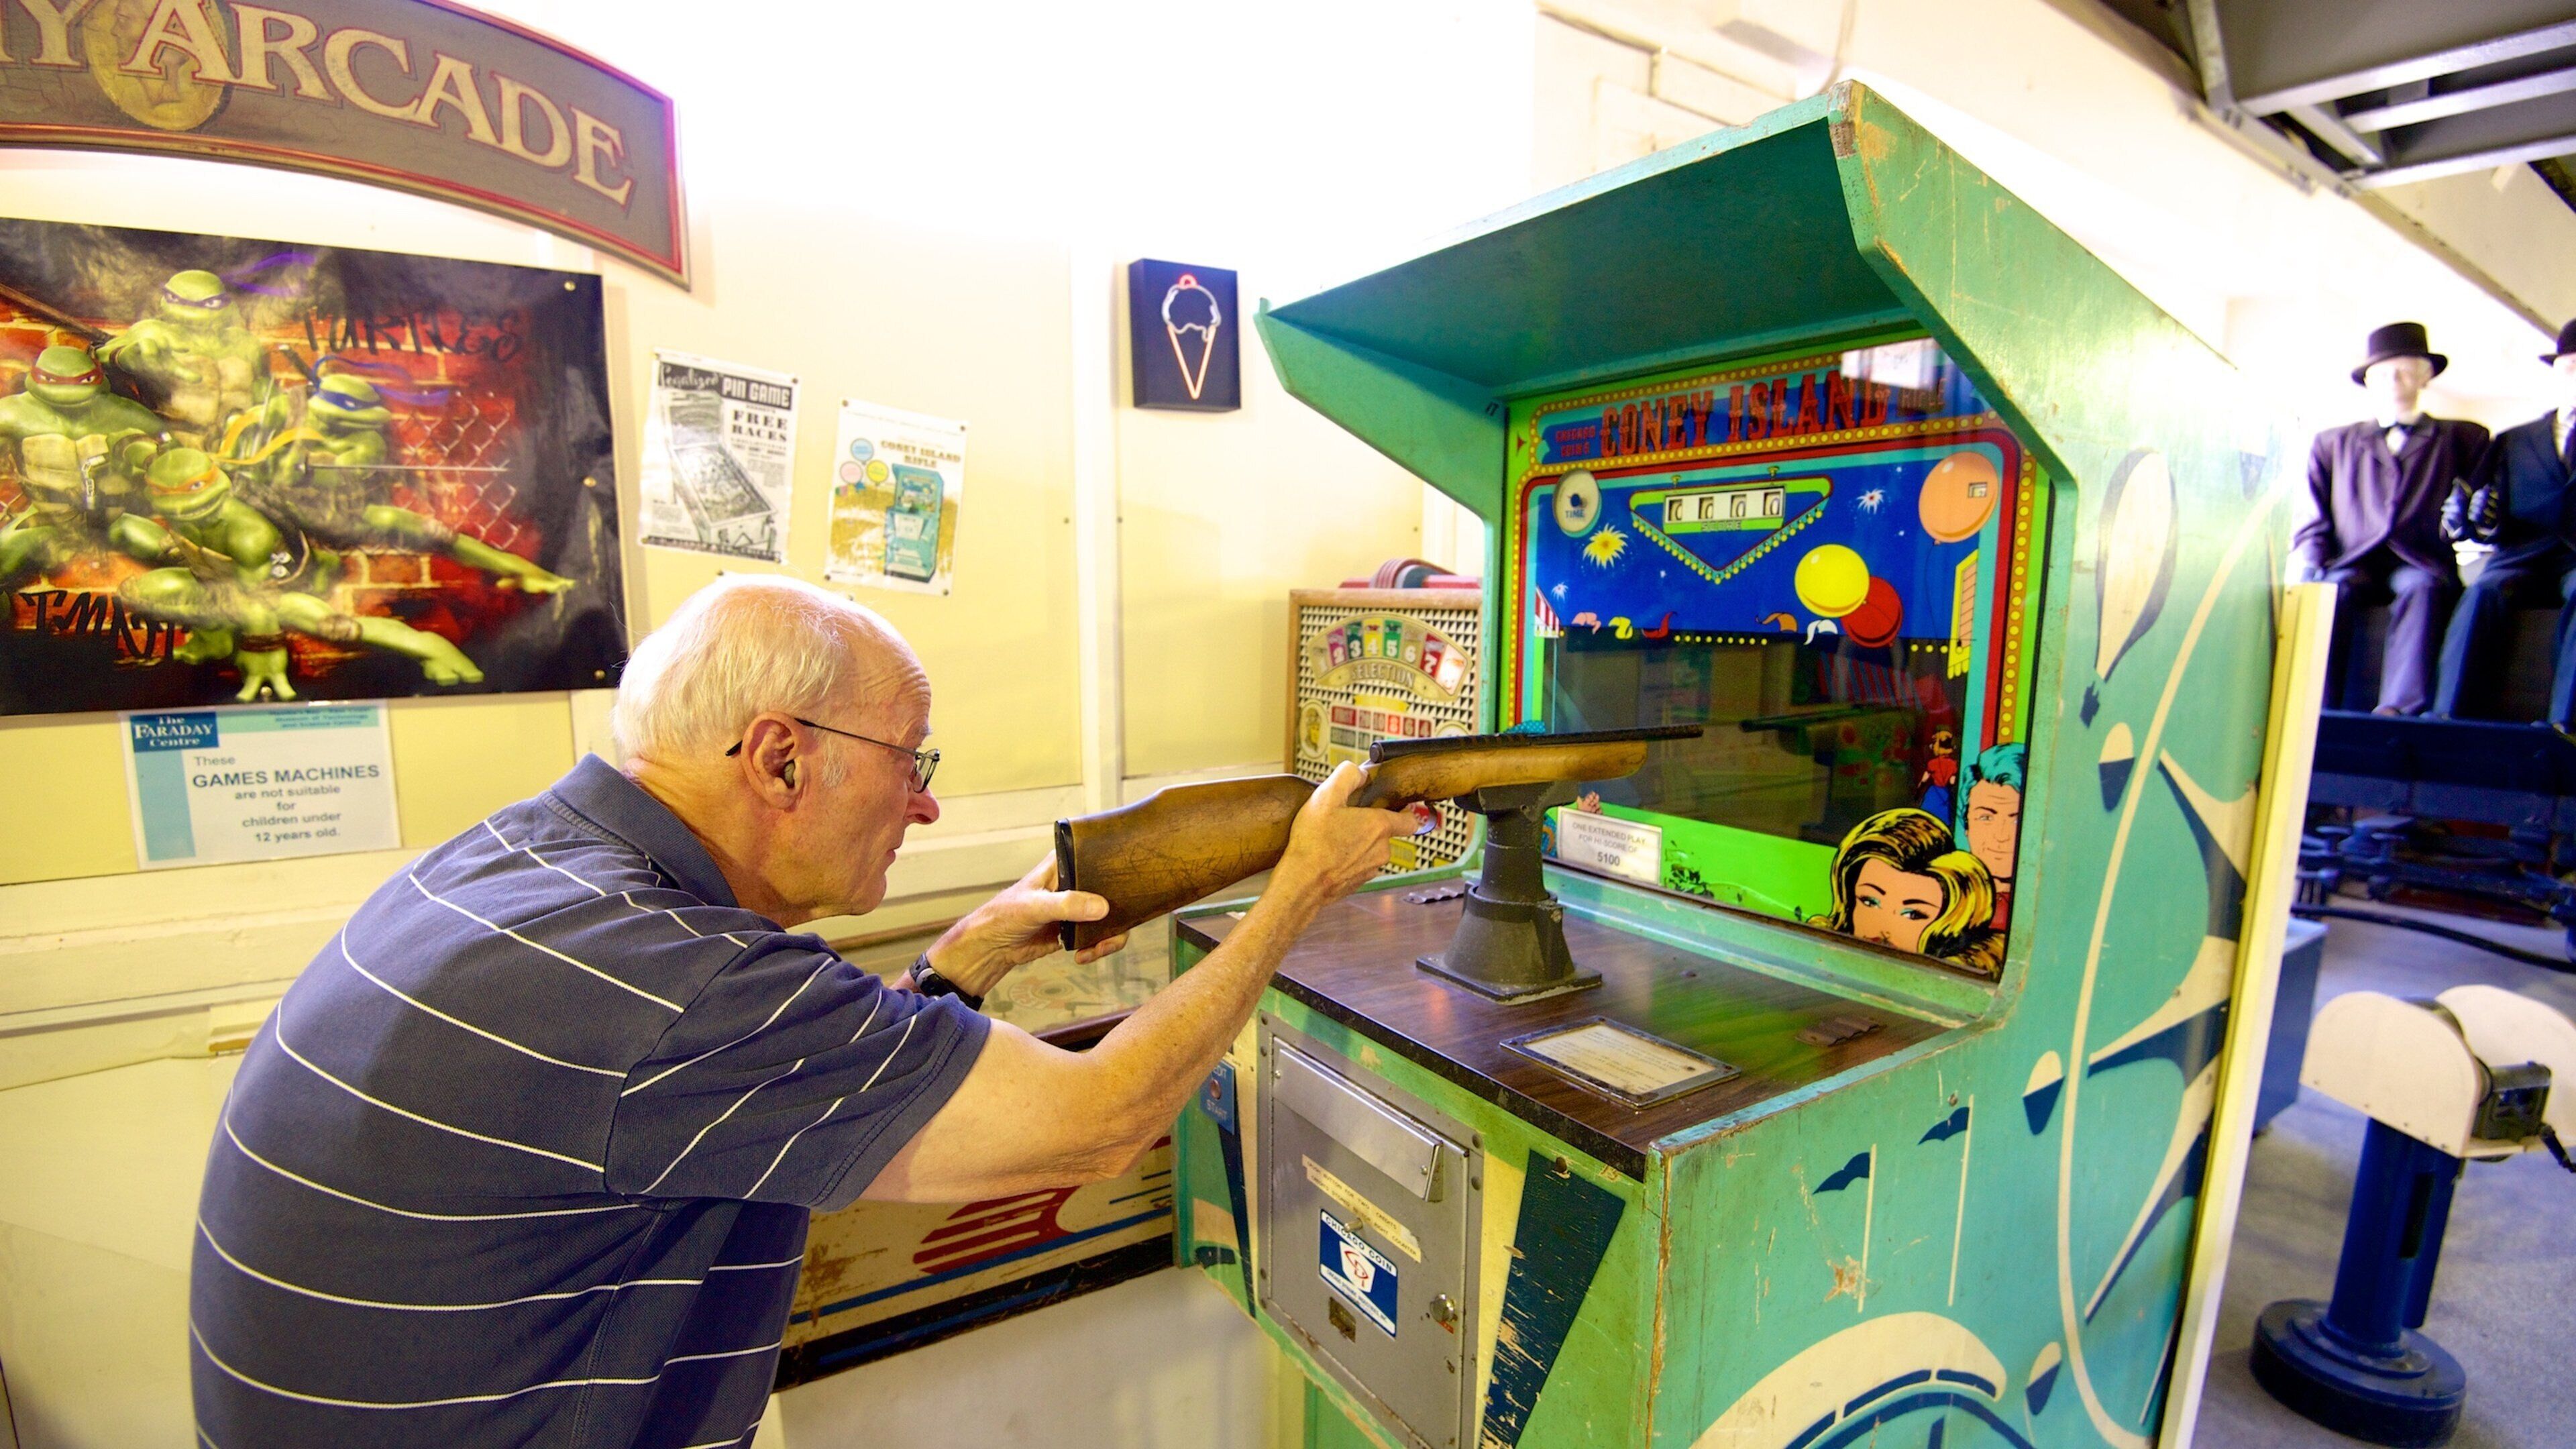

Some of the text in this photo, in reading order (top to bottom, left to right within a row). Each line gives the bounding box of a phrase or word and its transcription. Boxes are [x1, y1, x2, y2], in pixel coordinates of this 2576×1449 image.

[0, 0, 636, 208] Y ARCADE
[303, 302, 522, 363] TURTLES
[721, 376, 748, 399] PIN
[748, 381, 791, 409] GAME
[734, 409, 788, 430] FREE
[1600, 388, 1714, 459] CONEY
[1726, 369, 1890, 443] ISLAND
[732, 424, 787, 442] RACES
[880, 439, 917, 455] CONEY
[920, 448, 961, 463] ISLAND
[904, 455, 937, 468] RIFLE
[1565, 509, 1585, 519] TIME
[1701, 521, 1741, 532] SCORE
[1333, 646, 1345, 663] 2
[1350, 640, 1362, 657] 3
[1367, 638, 1379, 655] 4
[1387, 639, 1398, 657] 5
[1405, 645, 1416, 663] 6
[1424, 653, 1438, 674] 7
[1350, 660, 1415, 688] SELECTION
[158, 716, 185, 725] The
[133, 723, 214, 739] FARADAY
[149, 738, 201, 747] Centre
[194, 755, 235, 767] These
[193, 764, 380, 788] GAMES MACHINES
[235, 784, 341, 800] are not suitable
[276, 801, 297, 811] for
[241, 812, 342, 828] children under
[255, 826, 341, 844] 12 years old.
[1572, 821, 1646, 845] ONE EXTENDED PLAY
[1578, 834, 1639, 854] FOR HI-SCORE OF
[1597, 851, 1621, 867] 5100
[1375, 1212, 1397, 1230] CREDITS
[1326, 1215, 1393, 1273] CHICAGO COIN
[1391, 1235, 1417, 1256] COUNTER
